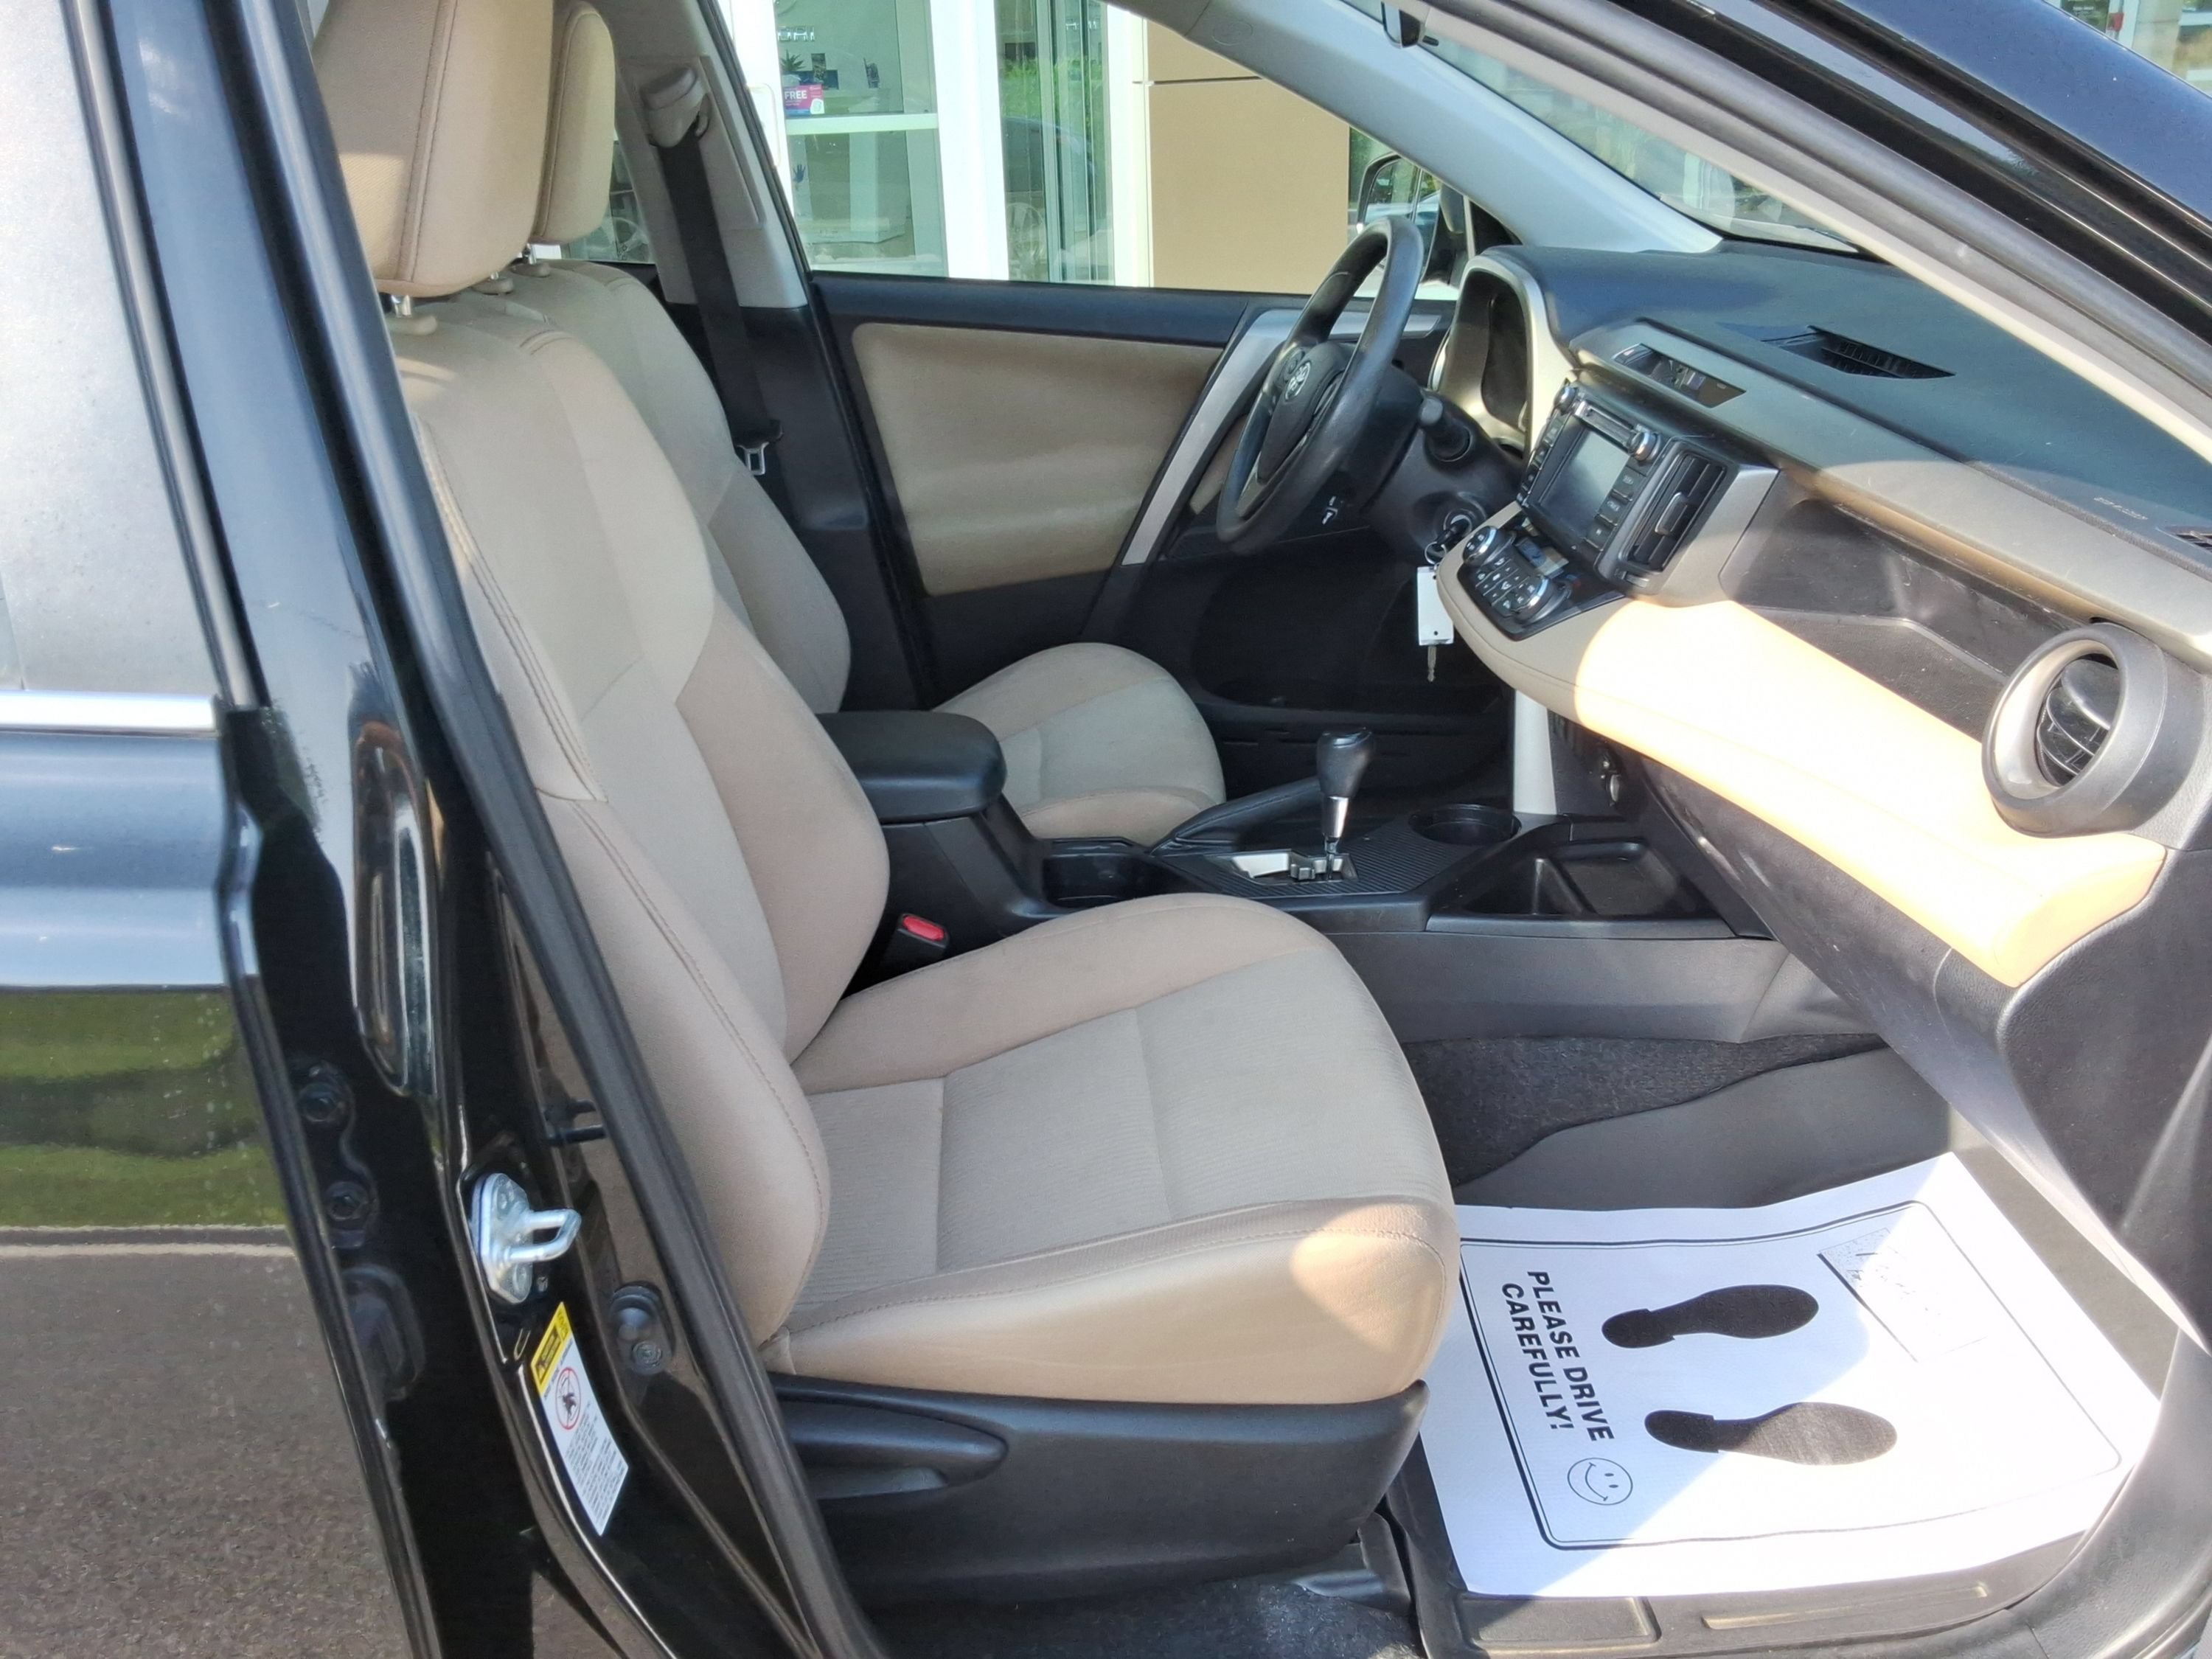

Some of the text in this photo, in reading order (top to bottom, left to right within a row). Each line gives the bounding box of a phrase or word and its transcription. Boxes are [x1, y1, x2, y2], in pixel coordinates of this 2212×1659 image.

[784, 90, 808, 100] FREE
[1501, 1283, 1575, 1430] CAREFULLY!
[1527, 1271, 1615, 1441] PLEASE DRIVE
